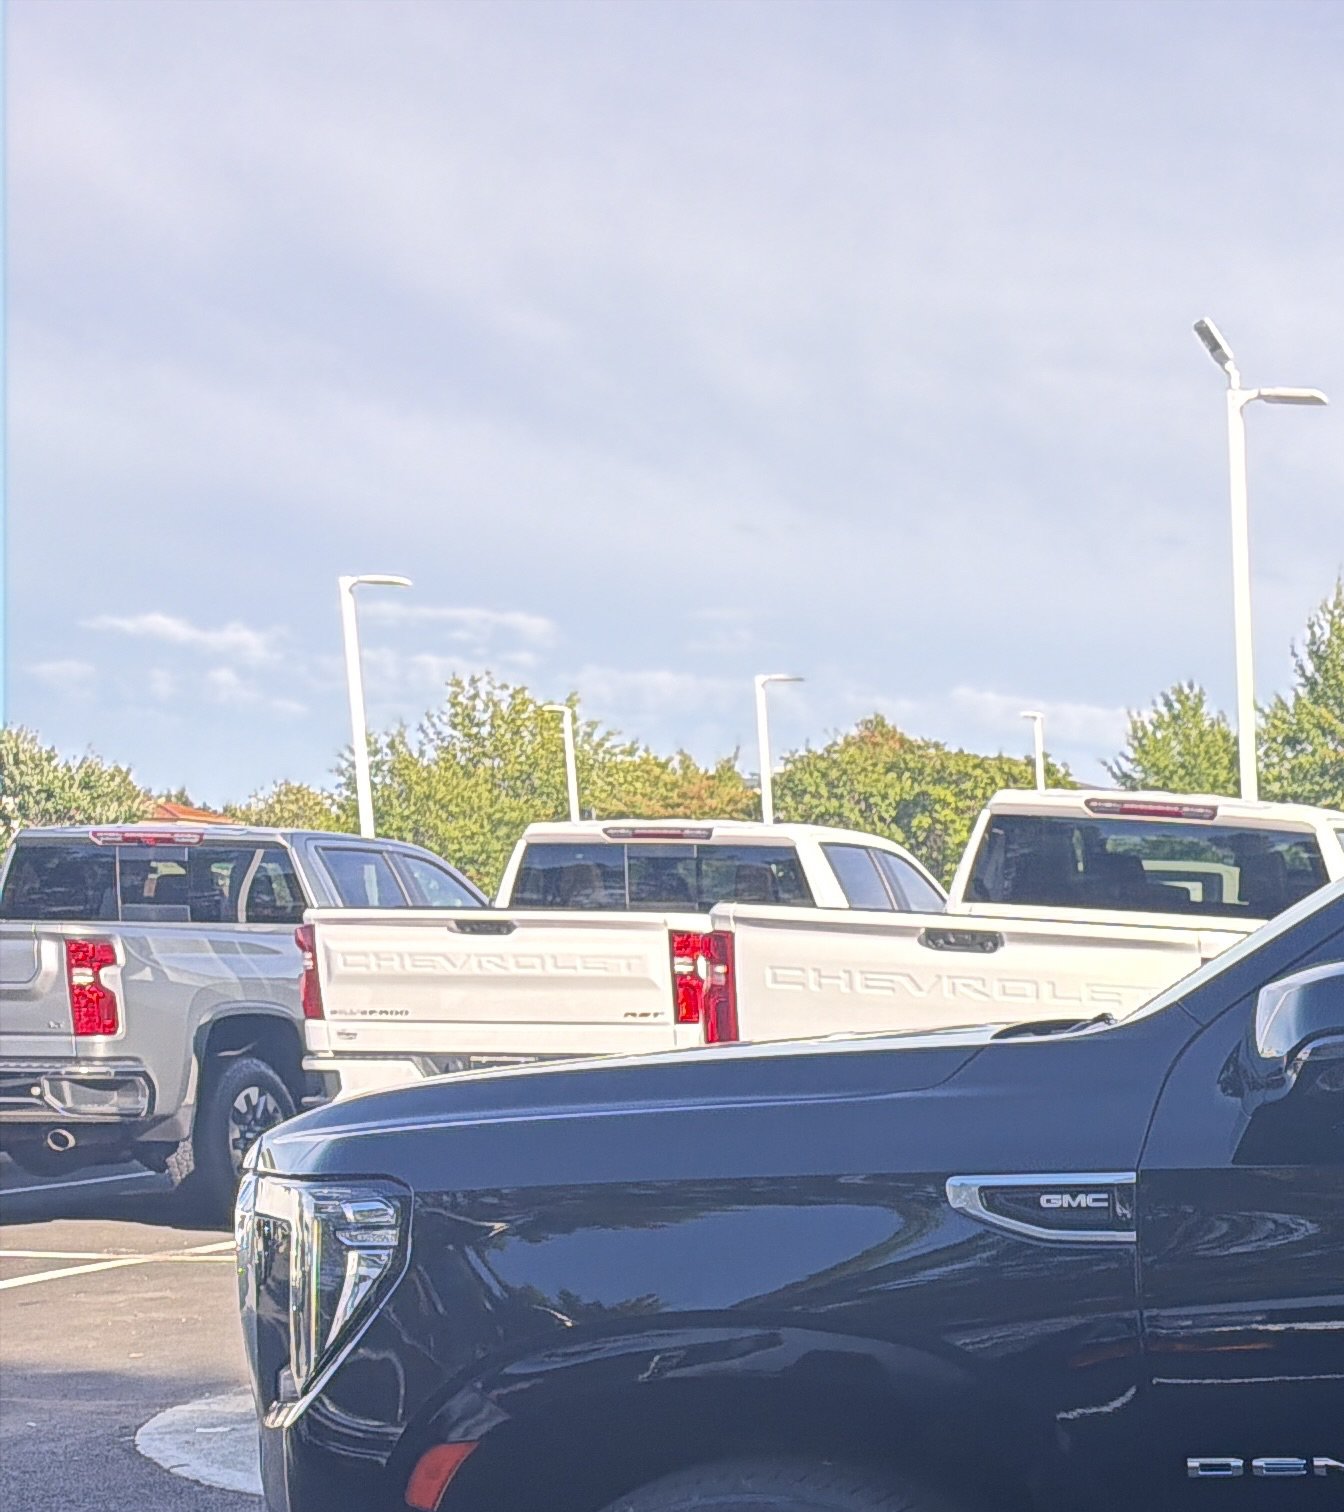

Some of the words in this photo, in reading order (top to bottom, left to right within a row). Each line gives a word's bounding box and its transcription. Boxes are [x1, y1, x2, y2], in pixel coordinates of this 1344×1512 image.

[337, 951, 647, 975] CHEVROLET
[764, 965, 1160, 1006] CHEVROLET
[1040, 1193, 1109, 1208] GMC
